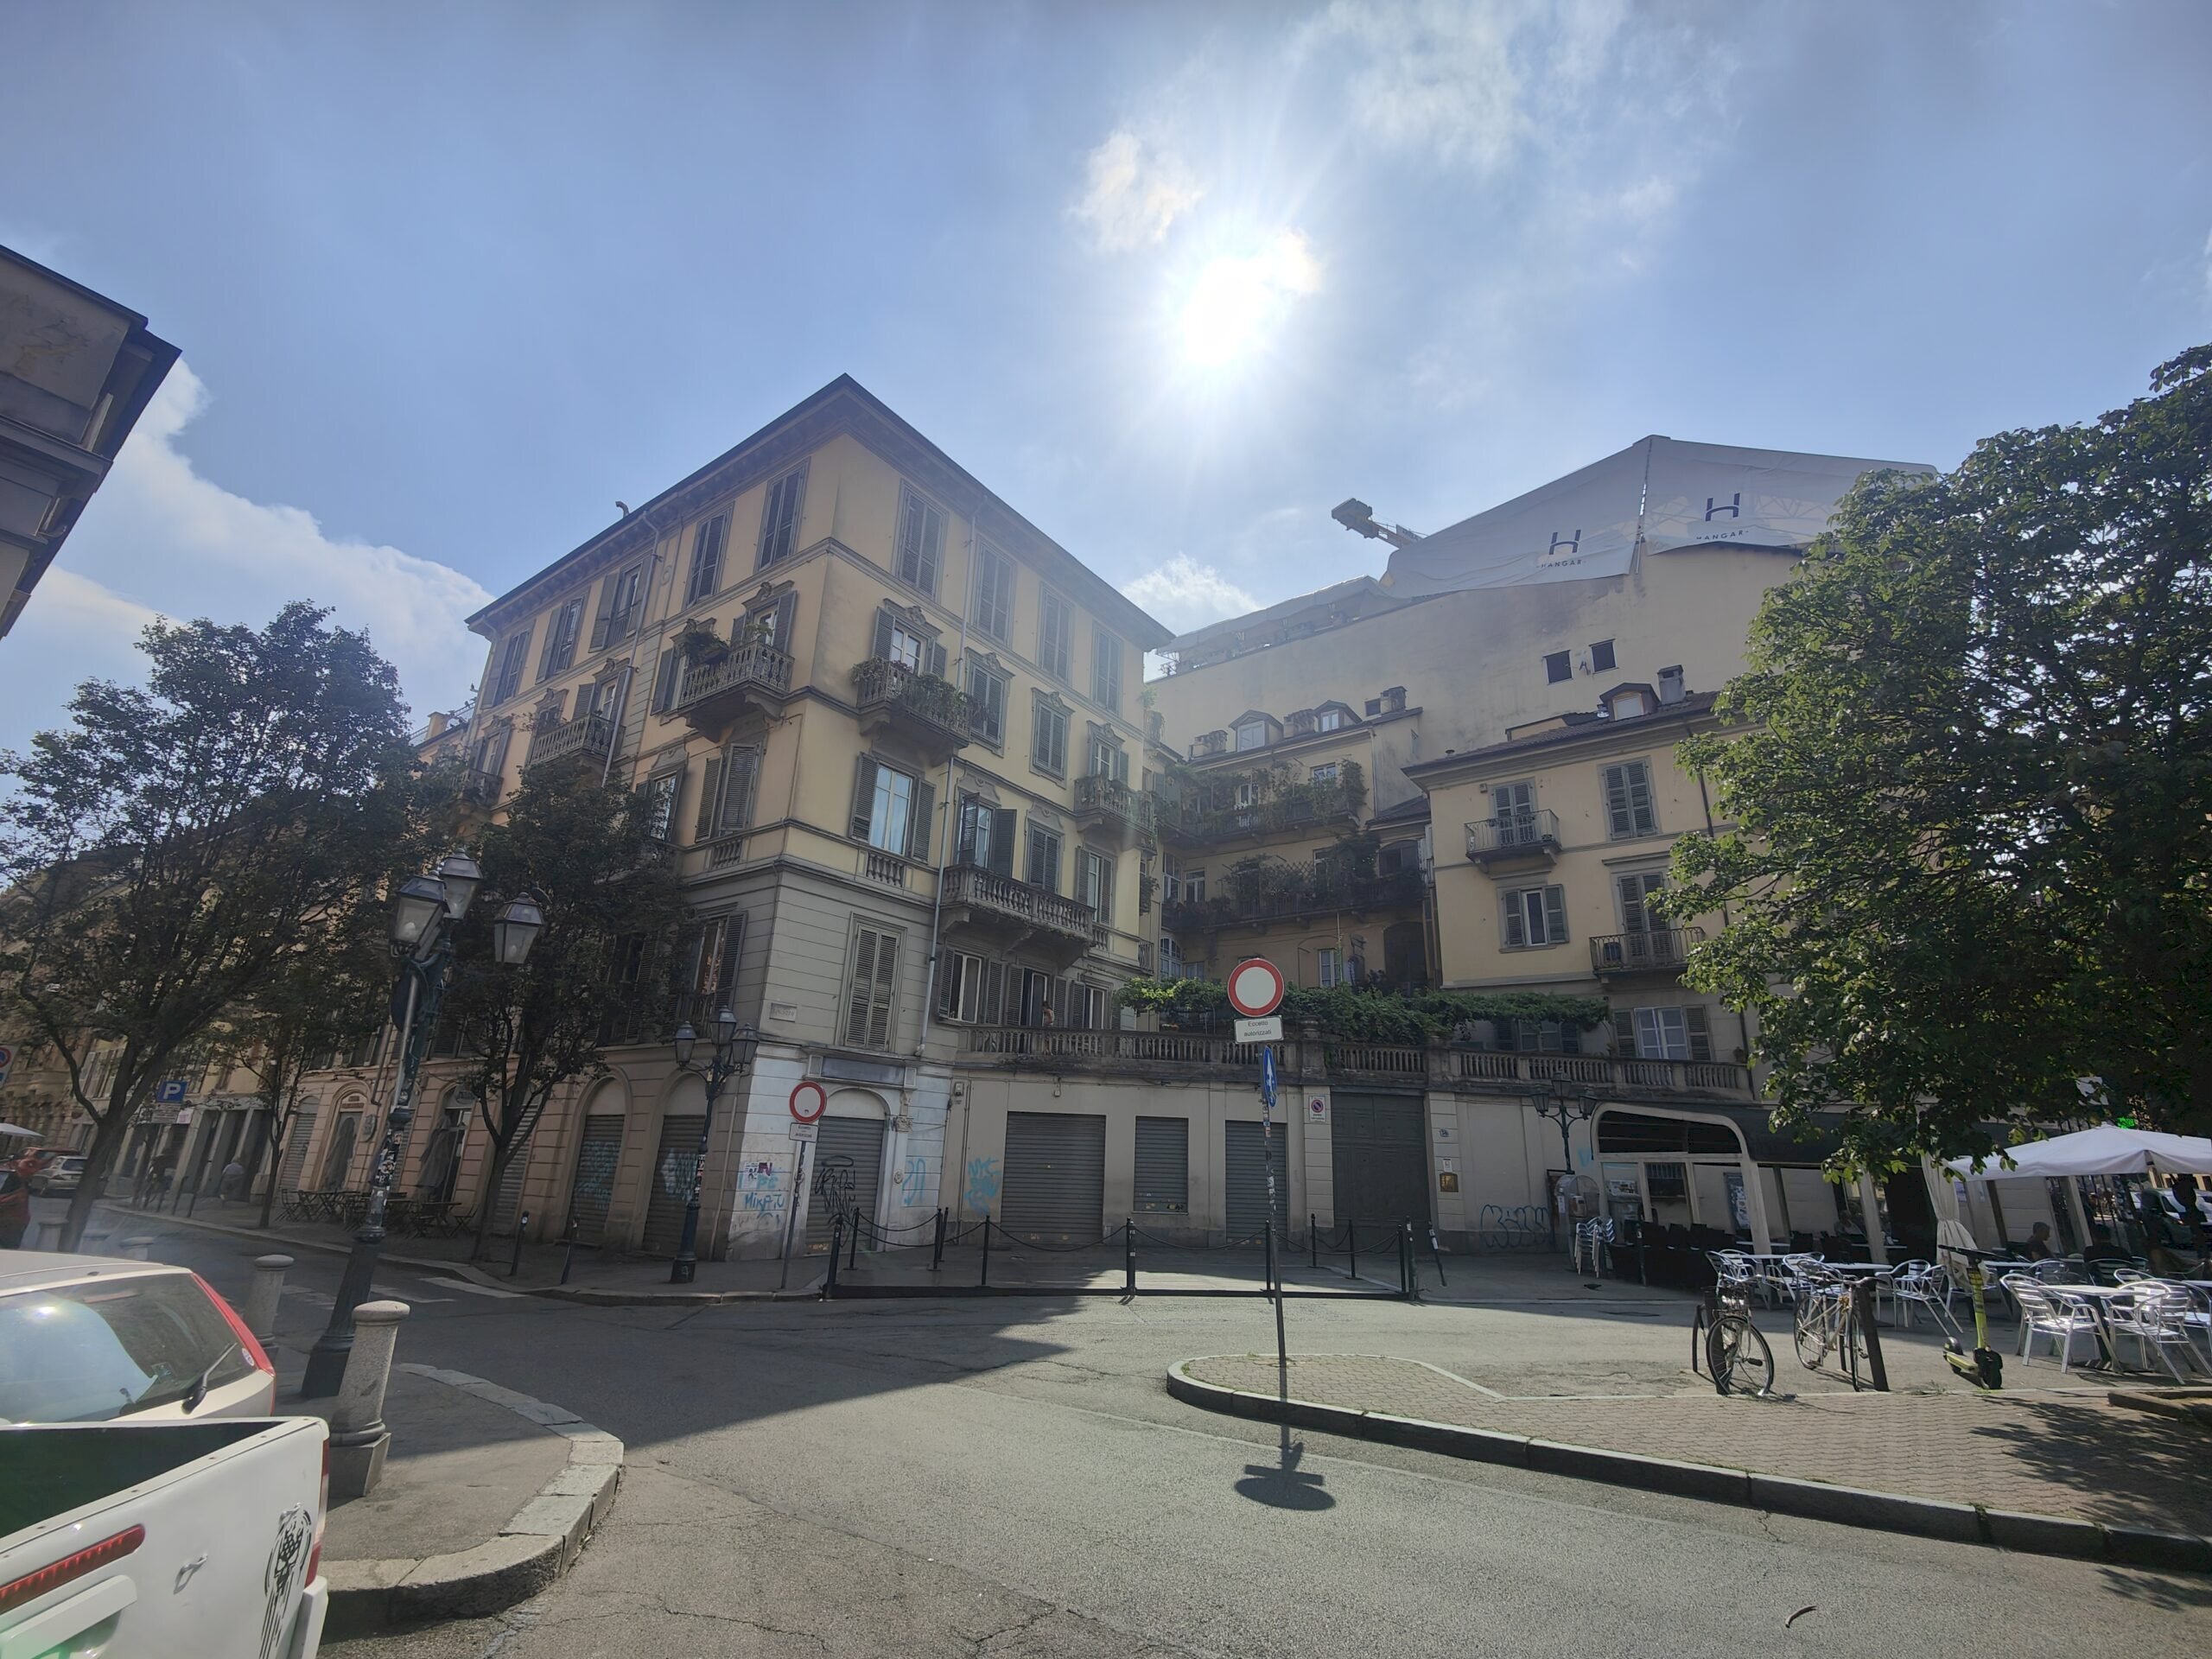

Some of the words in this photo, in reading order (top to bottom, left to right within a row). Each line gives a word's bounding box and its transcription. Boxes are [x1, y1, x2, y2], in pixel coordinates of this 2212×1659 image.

[1705, 493, 1740, 522] H
[1548, 529, 1581, 556] H
[163, 1083, 181, 1100] P
